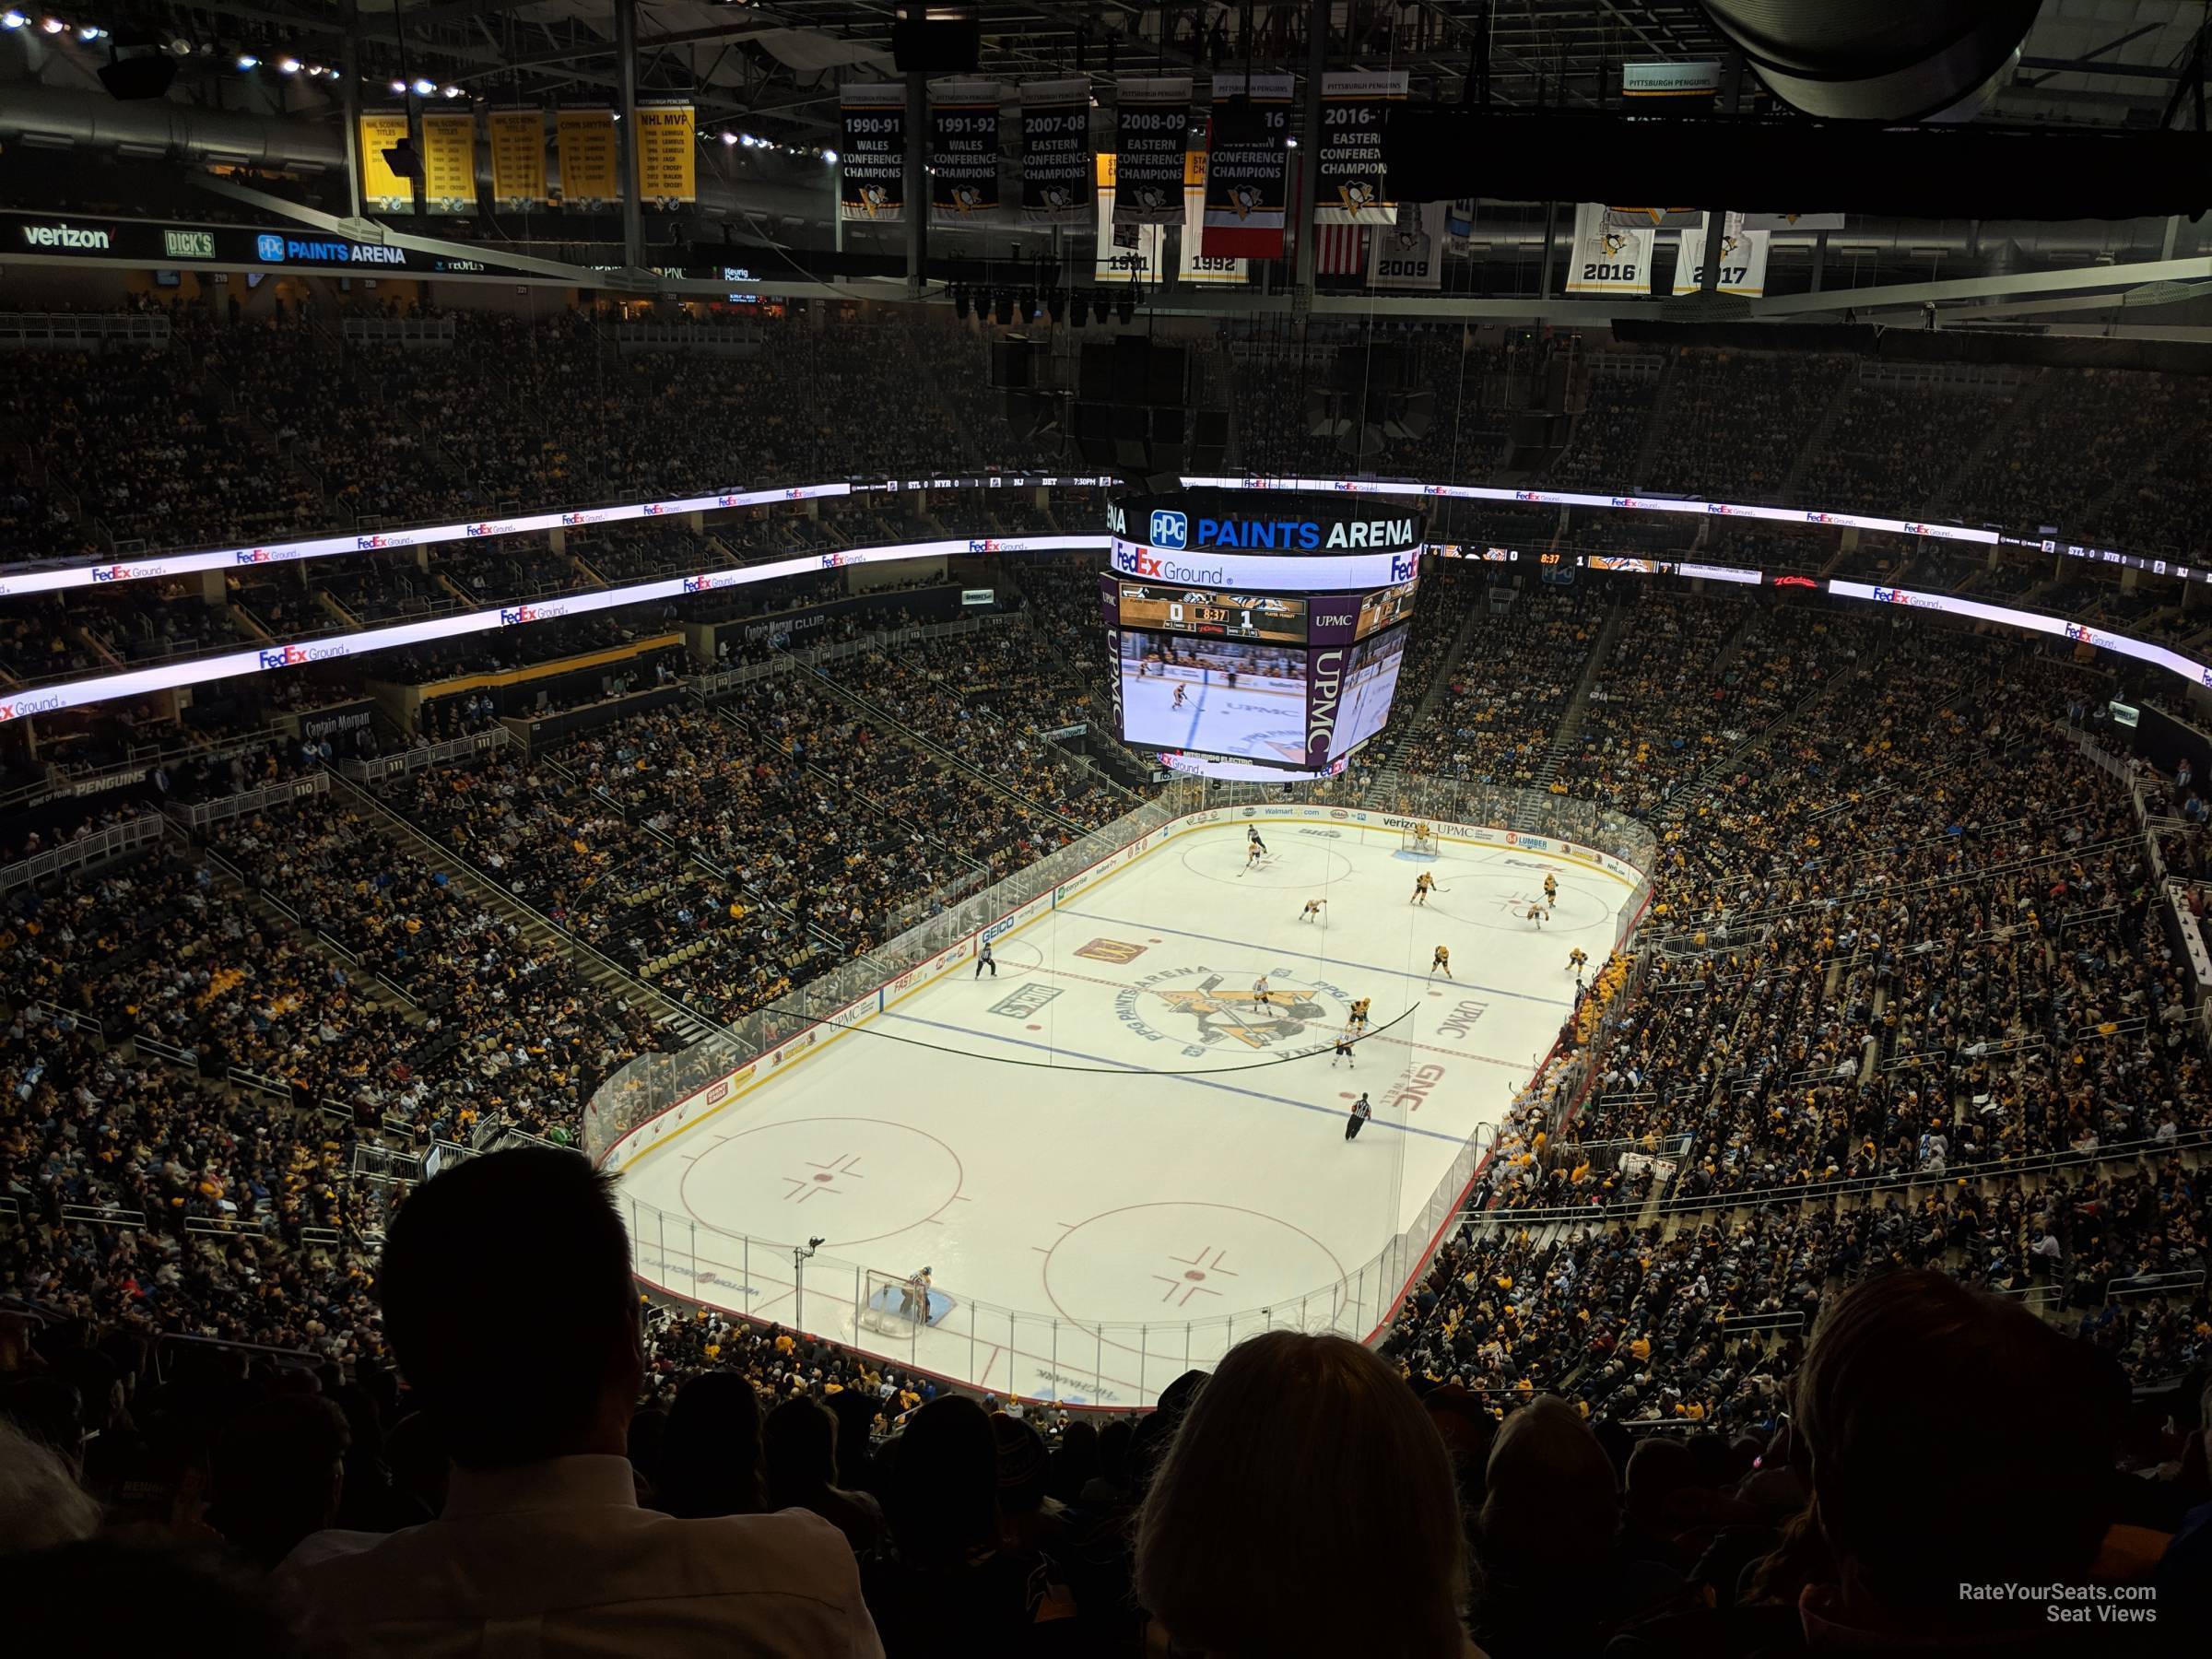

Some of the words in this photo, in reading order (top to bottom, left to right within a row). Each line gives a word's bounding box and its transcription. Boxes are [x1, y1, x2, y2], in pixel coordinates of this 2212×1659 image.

[641, 114, 662, 125] NHL
[665, 114, 688, 125] MVP
[1121, 113, 1186, 130] 2008-09
[1324, 107, 1381, 124] 2016-
[845, 117, 900, 133] 1990-91
[936, 117, 995, 133] 1991-92
[1025, 114, 1087, 133] 2007-08
[376, 128, 396, 136] TITLES
[856, 140, 889, 151] WALES
[948, 140, 983, 151] WALES
[1031, 138, 1078, 151] EASTERN
[1127, 139, 1176, 151] EASTERN
[1333, 133, 1381, 145] EASTER
[843, 153, 902, 165] CONFERENCE
[934, 153, 997, 165] CONFERENCE
[1023, 151, 1088, 165] CONFERENCE
[1118, 153, 1184, 166] CONFERENCE
[1211, 151, 1285, 163] CONFERENCE
[1320, 148, 1381, 160] CONFEREN
[844, 168, 901, 178] CHAMPIONS
[935, 167, 995, 179] CHAMPIONS
[1024, 166, 1086, 180] CHAMPIONS
[1118, 168, 1182, 181] CHAMPIONS
[1212, 167, 1281, 179] CHAMPIONS
[1321, 163, 1388, 175] CHAMPION
[23, 224, 110, 250] verizon
[168, 232, 213, 252] DICK'S
[261, 238, 283, 257] PPG
[287, 240, 348, 262] PAINTS
[351, 245, 406, 265] ARENA
[1109, 255, 1149, 271] 1991
[1192, 255, 1235, 271] 1992
[1379, 261, 1428, 276] 2009
[664, 267, 687, 280] PNC
[724, 267, 749, 277] Keurig
[1583, 265, 1635, 281] 2016
[1693, 266, 1747, 284] 217
[908, 481, 921, 489] STL
[924, 480, 929, 488] 0
[1244, 480, 1267, 489] FedEx
[1335, 482, 1358, 491] FedEx
[1424, 486, 1447, 496] FedEx
[786, 488, 802, 499] FedEx
[1516, 492, 1540, 501] FedEx
[719, 497, 737, 507] FedEx
[1612, 498, 1637, 508] FedEx
[643, 504, 664, 515] FedEx
[1708, 504, 1734, 515] FedEx
[562, 513, 584, 524] FedEx
[585, 514, 602, 523] Ground
[1806, 512, 1833, 524] FedEx
[1833, 516, 1854, 525] Ground
[466, 524, 492, 536] FedEx
[493, 524, 512, 533] Ground
[1152, 513, 1185, 544] PPG
[1198, 519, 1320, 549] PAINTS
[1325, 518, 1413, 548] ARENA
[1904, 524, 1930, 535] FedEx
[1930, 527, 1951, 537] Ground
[358, 536, 387, 549] FedEx
[388, 537, 410, 546] Ground
[970, 539, 1000, 552] FedEx
[1000, 542, 1024, 551] Ground
[236, 549, 270, 564] FedEx
[271, 550, 296, 559] Ground
[1510, 550, 1519, 561] 0
[1540, 553, 1560, 564] 8:37
[2068, 546, 2085, 557] STL
[2089, 549, 2095, 559] 0
[2103, 551, 2120, 563] NYR
[2122, 556, 2126, 564] 0
[822, 554, 843, 568] FedEx
[844, 554, 863, 564] Ground
[1117, 543, 1161, 577] FedEx
[1164, 564, 1223, 585] Ground
[1576, 556, 1583, 567] 1
[2139, 559, 2145, 569] 1
[92, 566, 131, 582] FedEx
[133, 566, 162, 578] Ground
[2177, 567, 2189, 578] NJ
[683, 575, 711, 593] FedEx
[712, 577, 733, 588] Ground
[1873, 587, 1910, 605] FedEx
[1910, 596, 1939, 609] Ground
[500, 606, 536, 625] FedEx
[537, 606, 565, 618] Ground
[1170, 604, 1183, 621] 0
[1203, 608, 1226, 621] 8:37
[1241, 611, 1253, 628] 1
[1316, 615, 1353, 627] UPMC
[746, 624, 769, 641] Captain
[795, 615, 824, 629] CLUB
[2065, 622, 2092, 642] FedEx
[2092, 633, 2113, 649] Ground
[259, 646, 307, 669] FedEx
[309, 644, 345, 660] Ground
[1108, 629, 1123, 729] UPMC
[13, 695, 58, 716] Ground
[1307, 650, 1342, 754] UPMC
[306, 718, 337, 738] Captain
[337, 711, 370, 731] Morgan
[1171, 759, 1199, 775] Ground
[1220, 755, 1253, 766] ELECTRIC
[52, 789, 72, 802] YOUR
[75, 769, 147, 797] PENGUINS
[295, 782, 313, 796] 110
[1265, 807, 1293, 816] Walmart
[1382, 817, 1418, 829] verizo
[1438, 823, 1475, 838] UPMC
[1519, 836, 1547, 848] LUMBER
[982, 915, 1014, 944] GEICO
[1134, 966, 1213, 989] ARENA
[1114, 988, 1137, 1021] PAINTS
[830, 1006, 860, 1033] UPMC
[1436, 1000, 1489, 1040] UPMC
[1126, 1022, 1164, 1041] PPG
[1393, 1064, 1446, 1112] GNC
